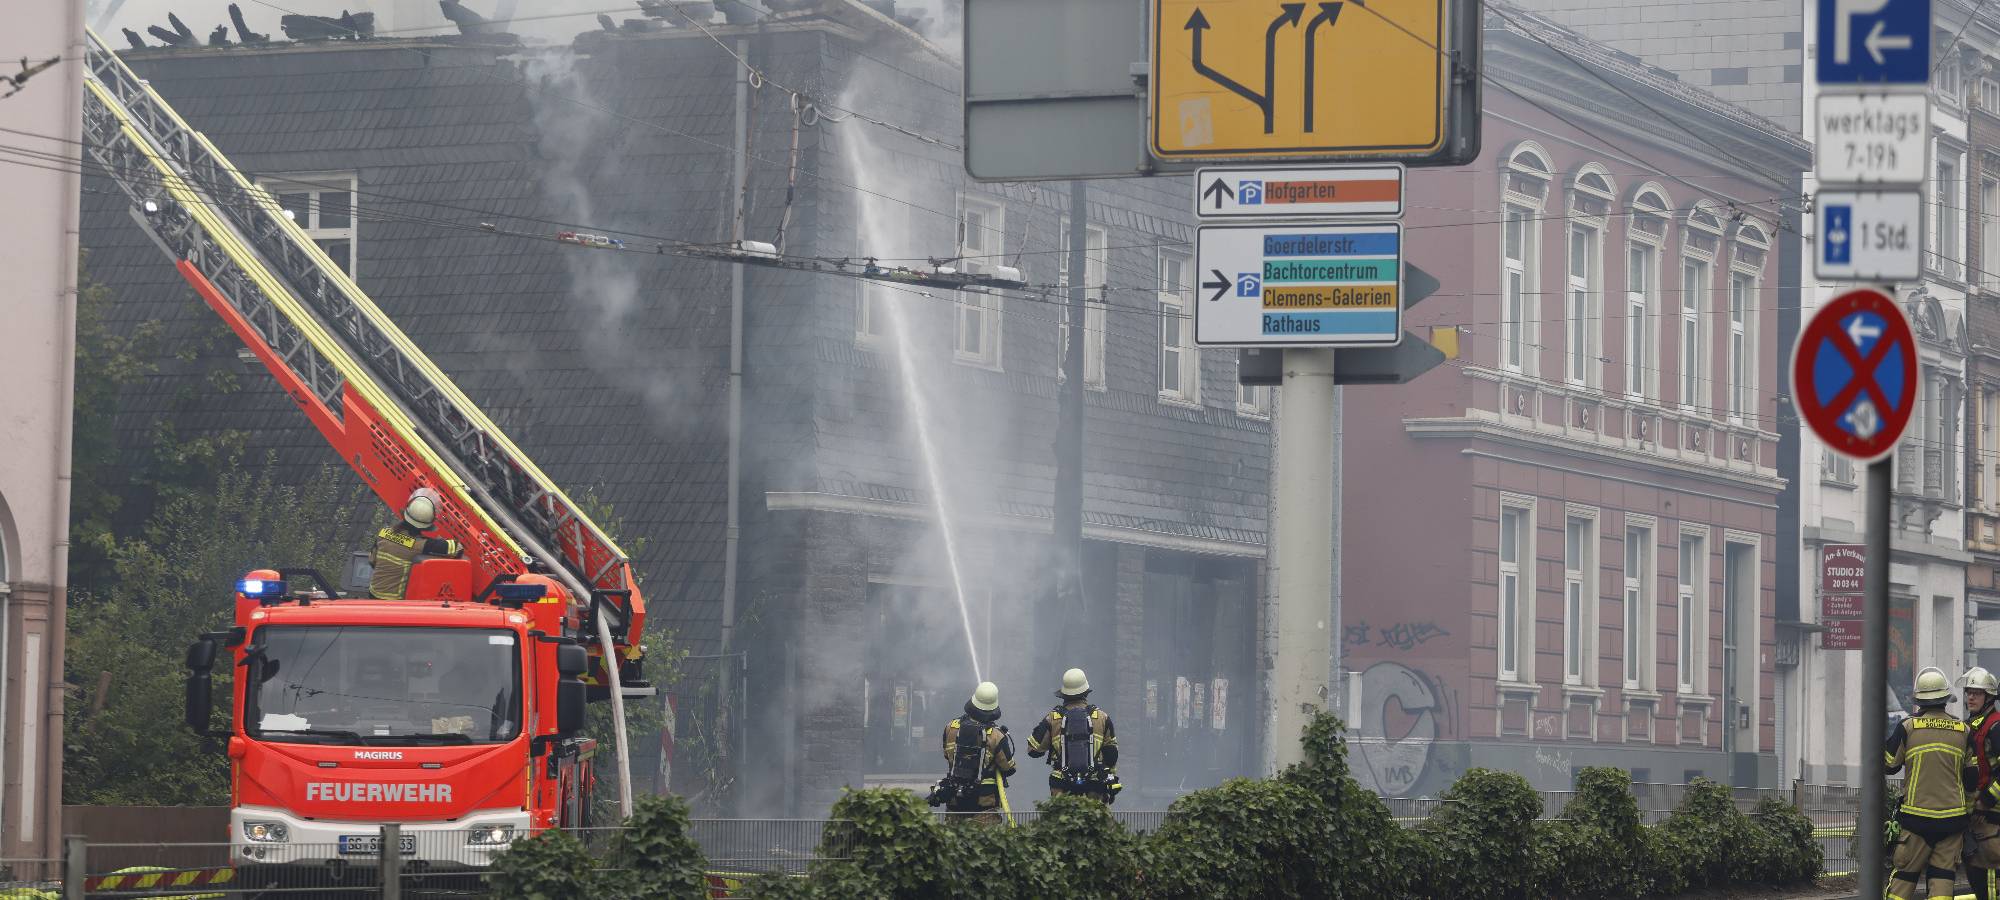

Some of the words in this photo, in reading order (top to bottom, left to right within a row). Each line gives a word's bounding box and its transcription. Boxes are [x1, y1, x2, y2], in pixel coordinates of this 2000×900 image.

[1824, 109, 1919, 141] werktags
[1265, 181, 1336, 203] Hofgarten
[1264, 236, 1357, 255] Goerdelerstr.
[1875, 223, 1911, 250] Std.
[1264, 262, 1378, 280] Bachtorcentrum
[1263, 288, 1392, 307] Clemens-Galerien
[1263, 315, 1321, 333] Rathaus
[1836, 549, 1842, 557] &
[1827, 567, 1854, 577] STUDIO
[1833, 579, 1841, 588] 20
[1842, 579, 1850, 588] 03
[1851, 580, 1859, 588] 44
[354, 751, 403, 760] MAGIRUS
[306, 783, 452, 803] FEUERWEHR
